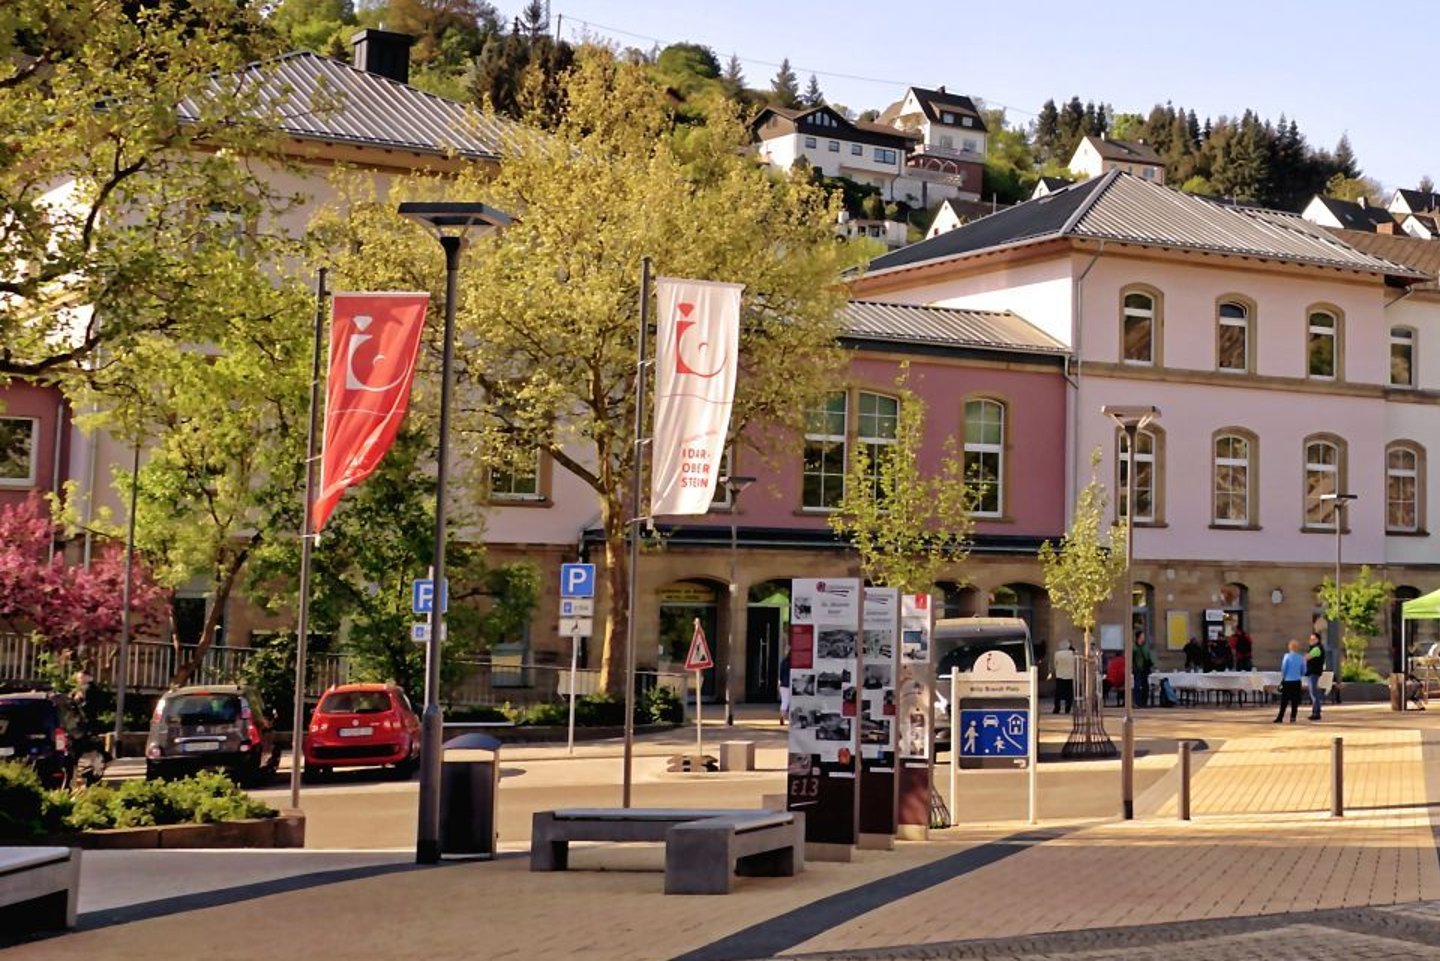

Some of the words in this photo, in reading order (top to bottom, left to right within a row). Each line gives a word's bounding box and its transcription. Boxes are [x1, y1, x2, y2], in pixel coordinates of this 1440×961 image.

[681, 462, 711, 474] OBER
[681, 477, 709, 488] STEIN
[568, 568, 587, 593] P
[790, 778, 820, 797] E13
